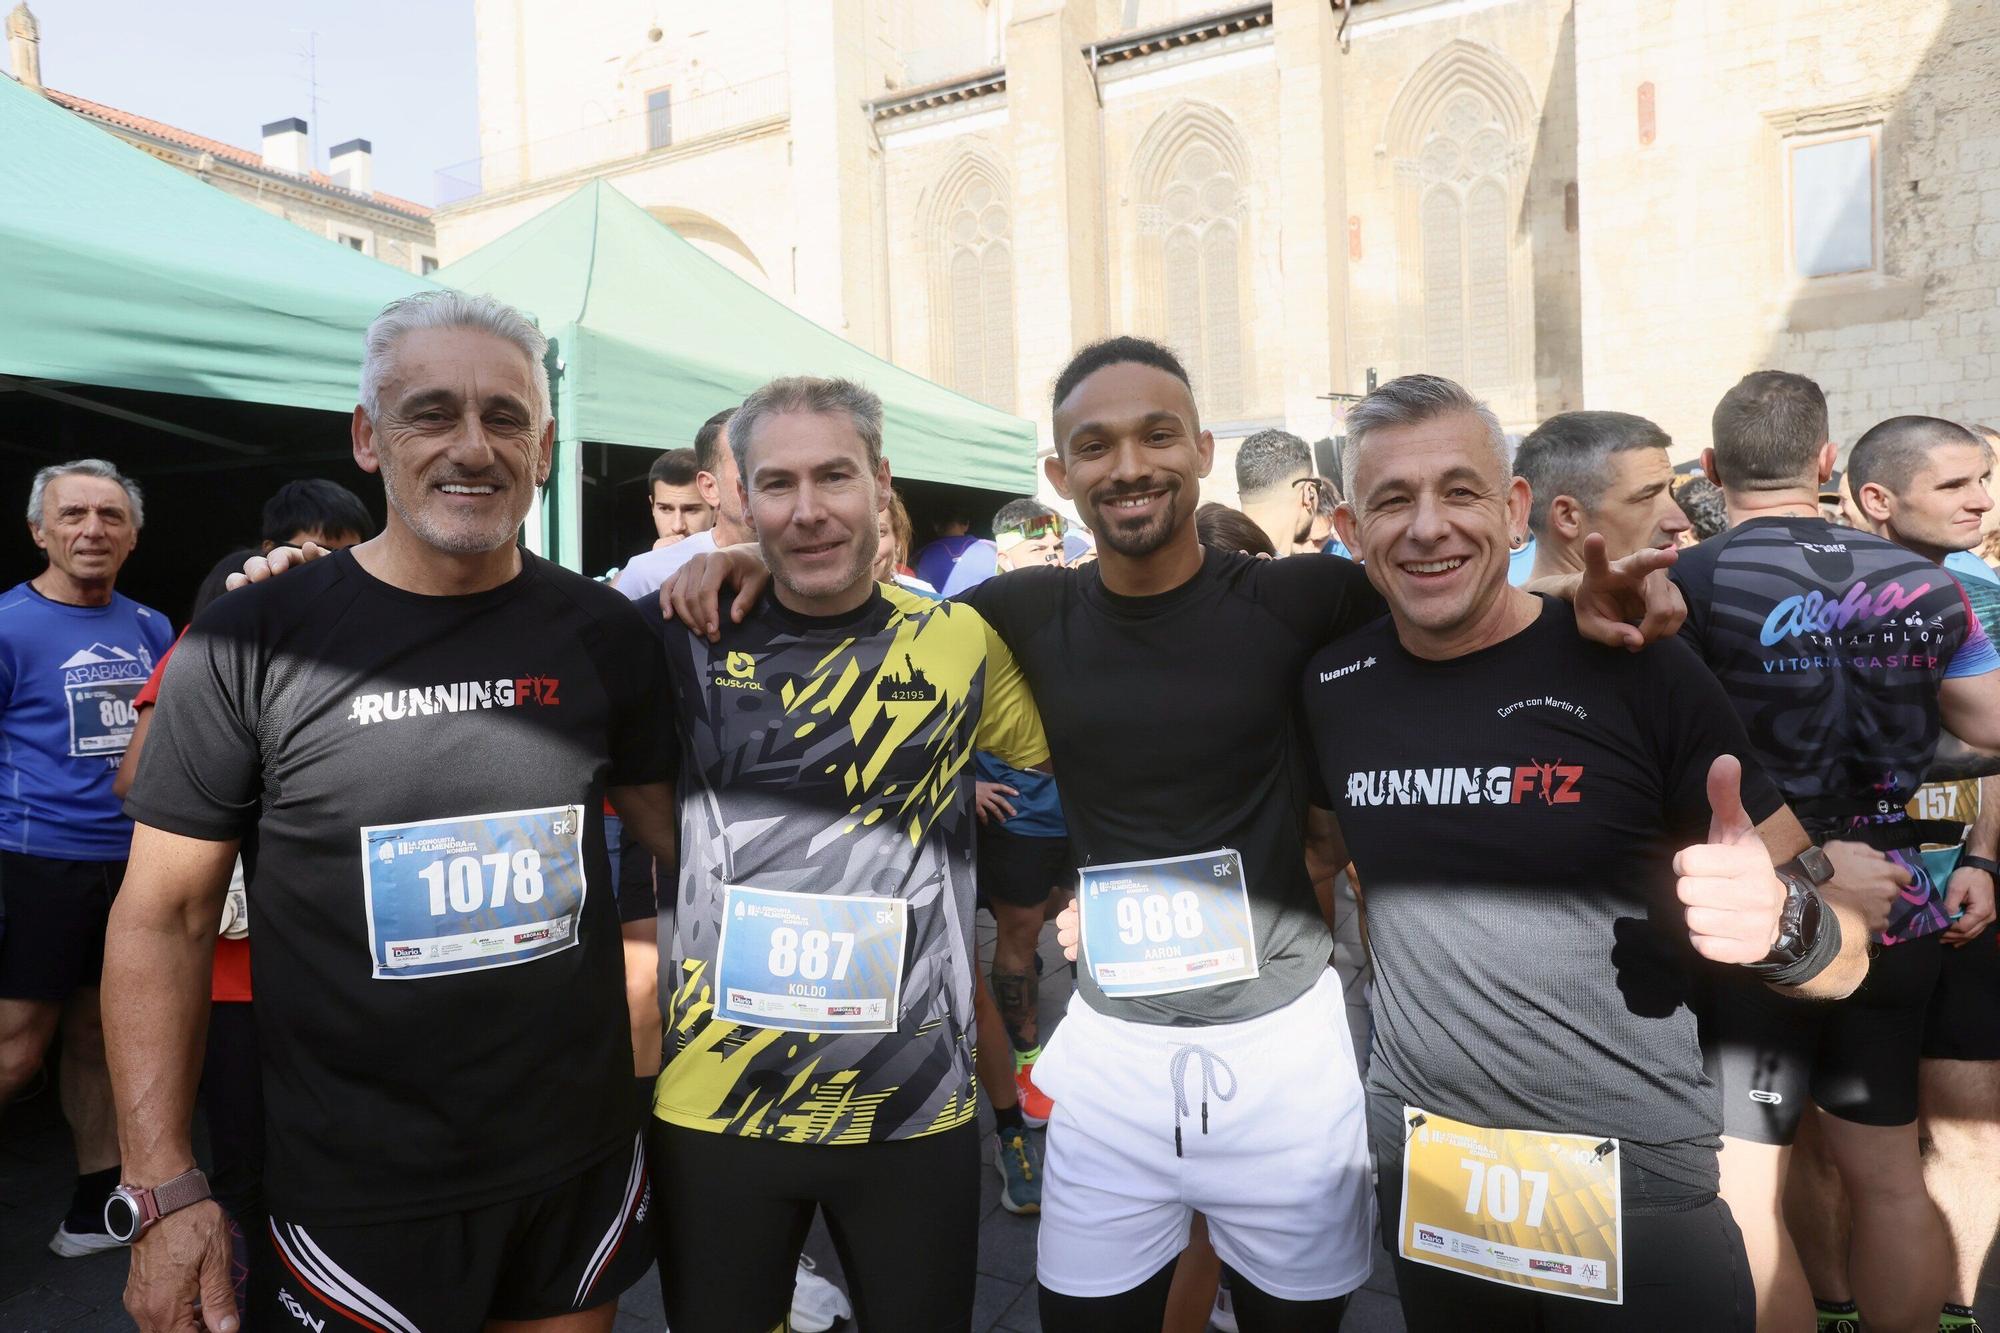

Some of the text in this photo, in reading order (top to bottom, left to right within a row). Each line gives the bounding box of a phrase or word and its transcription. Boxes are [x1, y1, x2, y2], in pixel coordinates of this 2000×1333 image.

[1810, 630, 1945, 648] TRIATHLON
[65, 662, 142, 685] ARABAKO
[1319, 660, 1361, 684] luanvi
[891, 690, 925, 700] 42195
[100, 700, 139, 727] 804
[1497, 700, 1525, 718] Corre
[1526, 698, 1543, 707] con
[1574, 705, 1588, 720] Fiz
[1913, 785, 1958, 820] 157
[553, 820, 572, 835] 5K
[1213, 863, 1232, 877] 5K
[418, 849, 545, 916] 1078
[876, 911, 896, 925] 5K
[1117, 890, 1204, 945] 988
[768, 927, 855, 981] 887
[1144, 946, 1182, 960] AARON
[788, 983, 827, 998] KOLDO
[1460, 1158, 1549, 1228] 707
[1421, 1233, 1443, 1245] Diario
[1536, 1260, 1561, 1270] LABORAL
